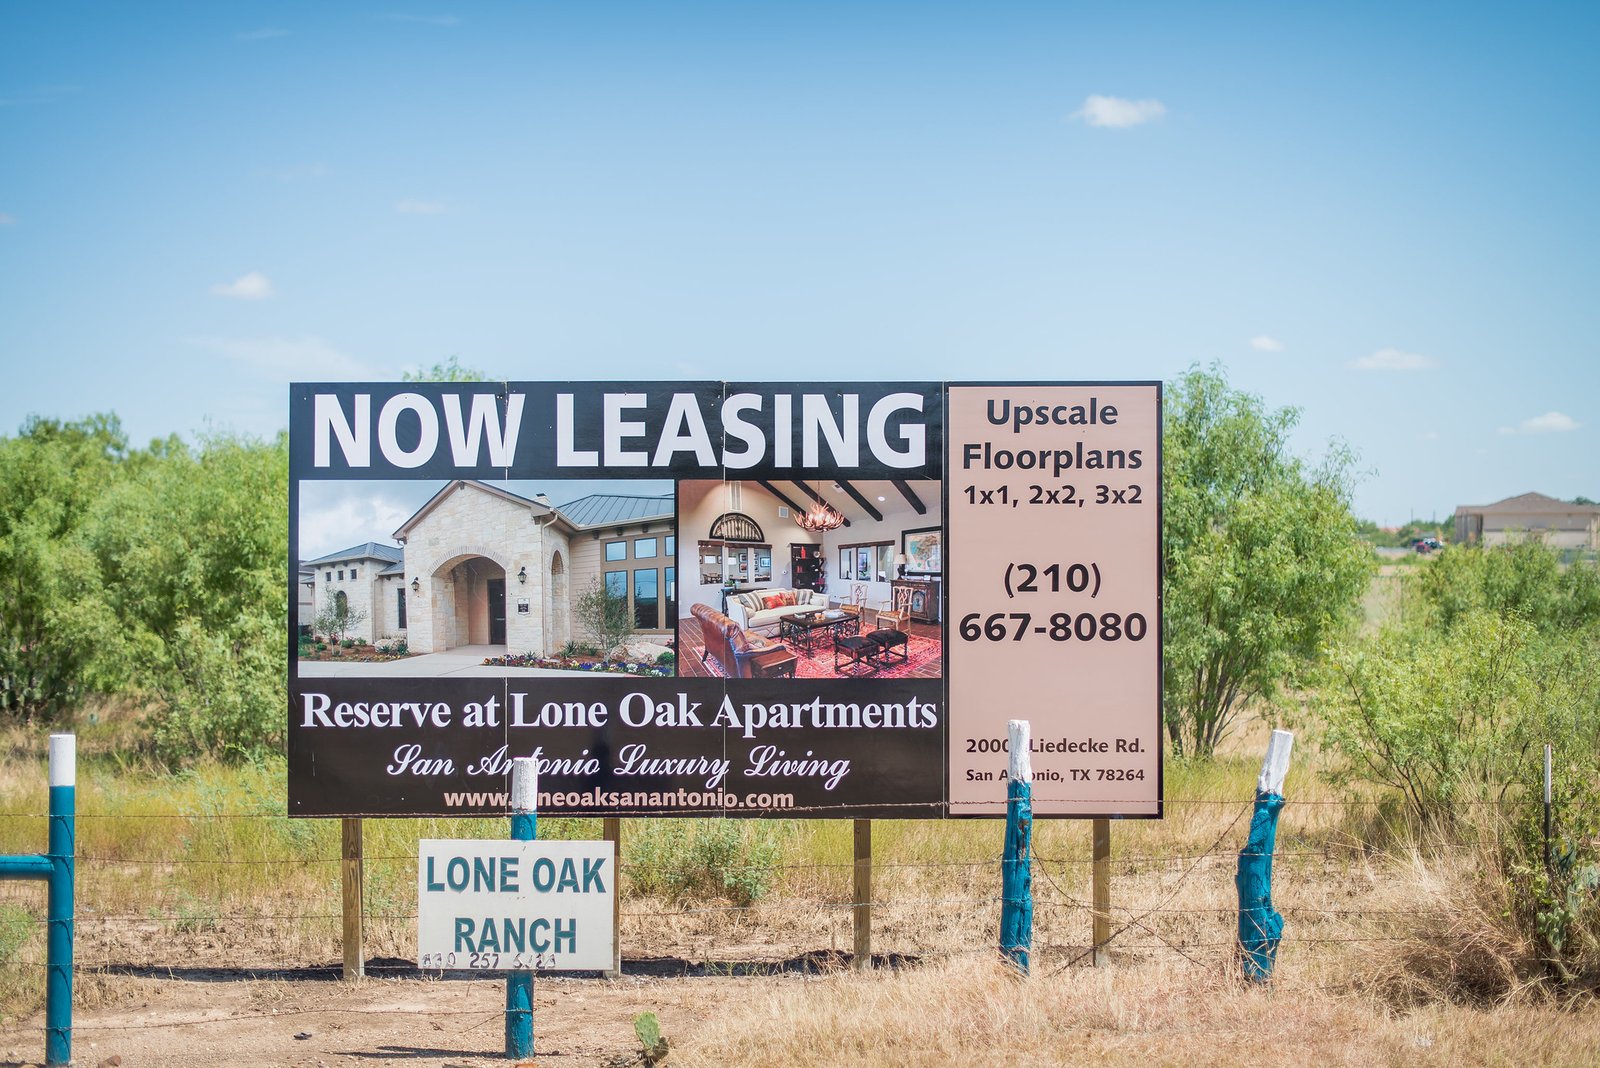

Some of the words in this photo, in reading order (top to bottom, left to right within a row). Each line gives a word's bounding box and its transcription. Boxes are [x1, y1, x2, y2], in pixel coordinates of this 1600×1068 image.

[313, 393, 526, 468] NOW
[556, 392, 926, 469] LEASING
[987, 398, 1118, 433] Upscale
[963, 442, 1142, 477] Floorplans
[964, 485, 1018, 508] 1x1,
[1029, 485, 1085, 508] 2x2,
[1095, 485, 1142, 505] 3x2
[1004, 562, 1101, 598] (210)
[959, 612, 1147, 642] 667-8080
[300, 693, 451, 728] Reserve
[463, 695, 500, 727] at
[510, 693, 608, 727] Lone
[619, 692, 703, 728] Oak
[710, 694, 937, 738] Apartments
[1029, 738, 1109, 753] Liedecke
[1115, 738, 1145, 753] Rd.
[387, 744, 455, 776] San
[613, 744, 730, 789] Luxury
[744, 745, 850, 790] Living
[966, 769, 993, 781] San
[999, 769, 1065, 783] Anio,
[1070, 769, 1091, 781] TX
[1096, 769, 1145, 781] 78264
[443, 787, 794, 808] www.neoaksanantonio.com
[427, 856, 520, 893] LONE
[532, 857, 607, 893] OAK
[454, 917, 576, 954] RANCH
[469, 953, 499, 968] 257
